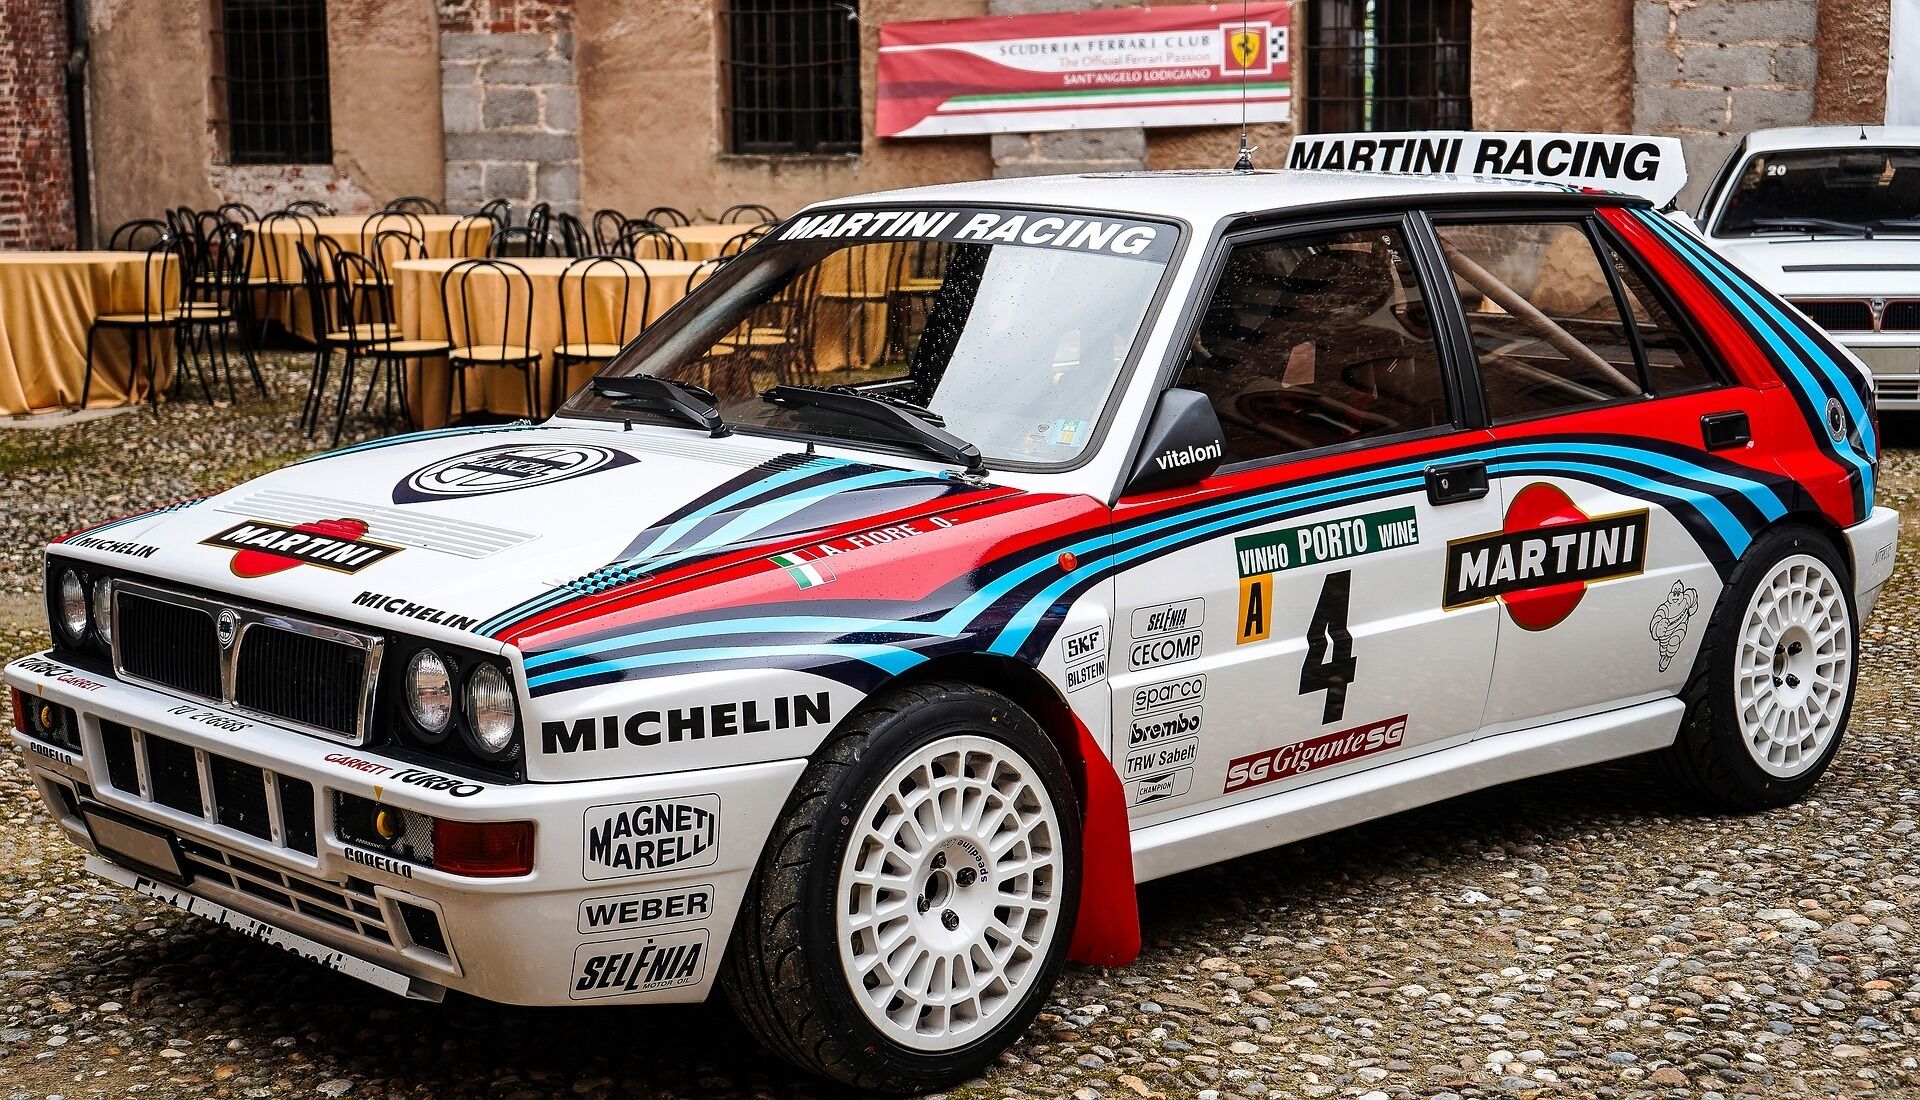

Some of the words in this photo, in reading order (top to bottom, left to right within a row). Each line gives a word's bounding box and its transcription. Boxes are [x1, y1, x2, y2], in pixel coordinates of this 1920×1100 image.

[1000, 42, 1080, 56] SCUDERIA
[1088, 38, 1156, 51] FERRARI
[1165, 36, 1210, 48] CLUB
[1059, 57, 1079, 68] The
[1082, 55, 1121, 66] Official
[1125, 53, 1162, 65] Ferrari
[1167, 52, 1211, 62] Passion
[1063, 72, 1143, 85] SANT'ANGELO
[1144, 68, 1212, 81] LODIGIANO
[1289, 138, 1463, 173] MARTINI
[1473, 138, 1661, 181] RACING
[1767, 165, 1787, 176] 20
[778, 211, 961, 241] MARTINI
[955, 214, 1157, 256] RACING
[1156, 439, 1222, 471] vitaloni
[76, 538, 160, 559] MICHELIN
[221, 525, 383, 566] MARTINI
[817, 544, 851, 557] A.
[846, 524, 924, 549] FIORE
[1239, 543, 1289, 576] VINHO
[1297, 518, 1368, 564] PORTO
[1377, 518, 1418, 548] WINE
[1458, 524, 1636, 592] MARTINI
[352, 590, 479, 631] MICHELIN
[1243, 582, 1263, 637] A
[1068, 631, 1099, 658] SKF
[1131, 634, 1201, 667] CECOMP
[1298, 569, 1357, 725] 4
[12, 657, 74, 677] TURBO
[57, 674, 108, 692] GARRETT
[1067, 660, 1105, 688] BILSTEIN
[1134, 678, 1203, 711] sparco
[541, 691, 832, 755] MICHELIN
[1131, 712, 1200, 745] brembo
[1127, 753, 1155, 774] TRW
[1158, 744, 1196, 766] Sabelt
[1226, 757, 1271, 789] SG
[1272, 731, 1364, 773] Gigante
[1364, 720, 1405, 751] SG
[324, 753, 395, 776] GARRETT
[390, 767, 485, 798] TURBO
[1139, 781, 1172, 796] CHAMPION
[590, 803, 715, 848] MAGNETI
[590, 825, 715, 870] MARELLI
[957, 838, 989, 883] speedline
[586, 892, 709, 927] WEBER
[643, 980, 673, 989] MOTOR
